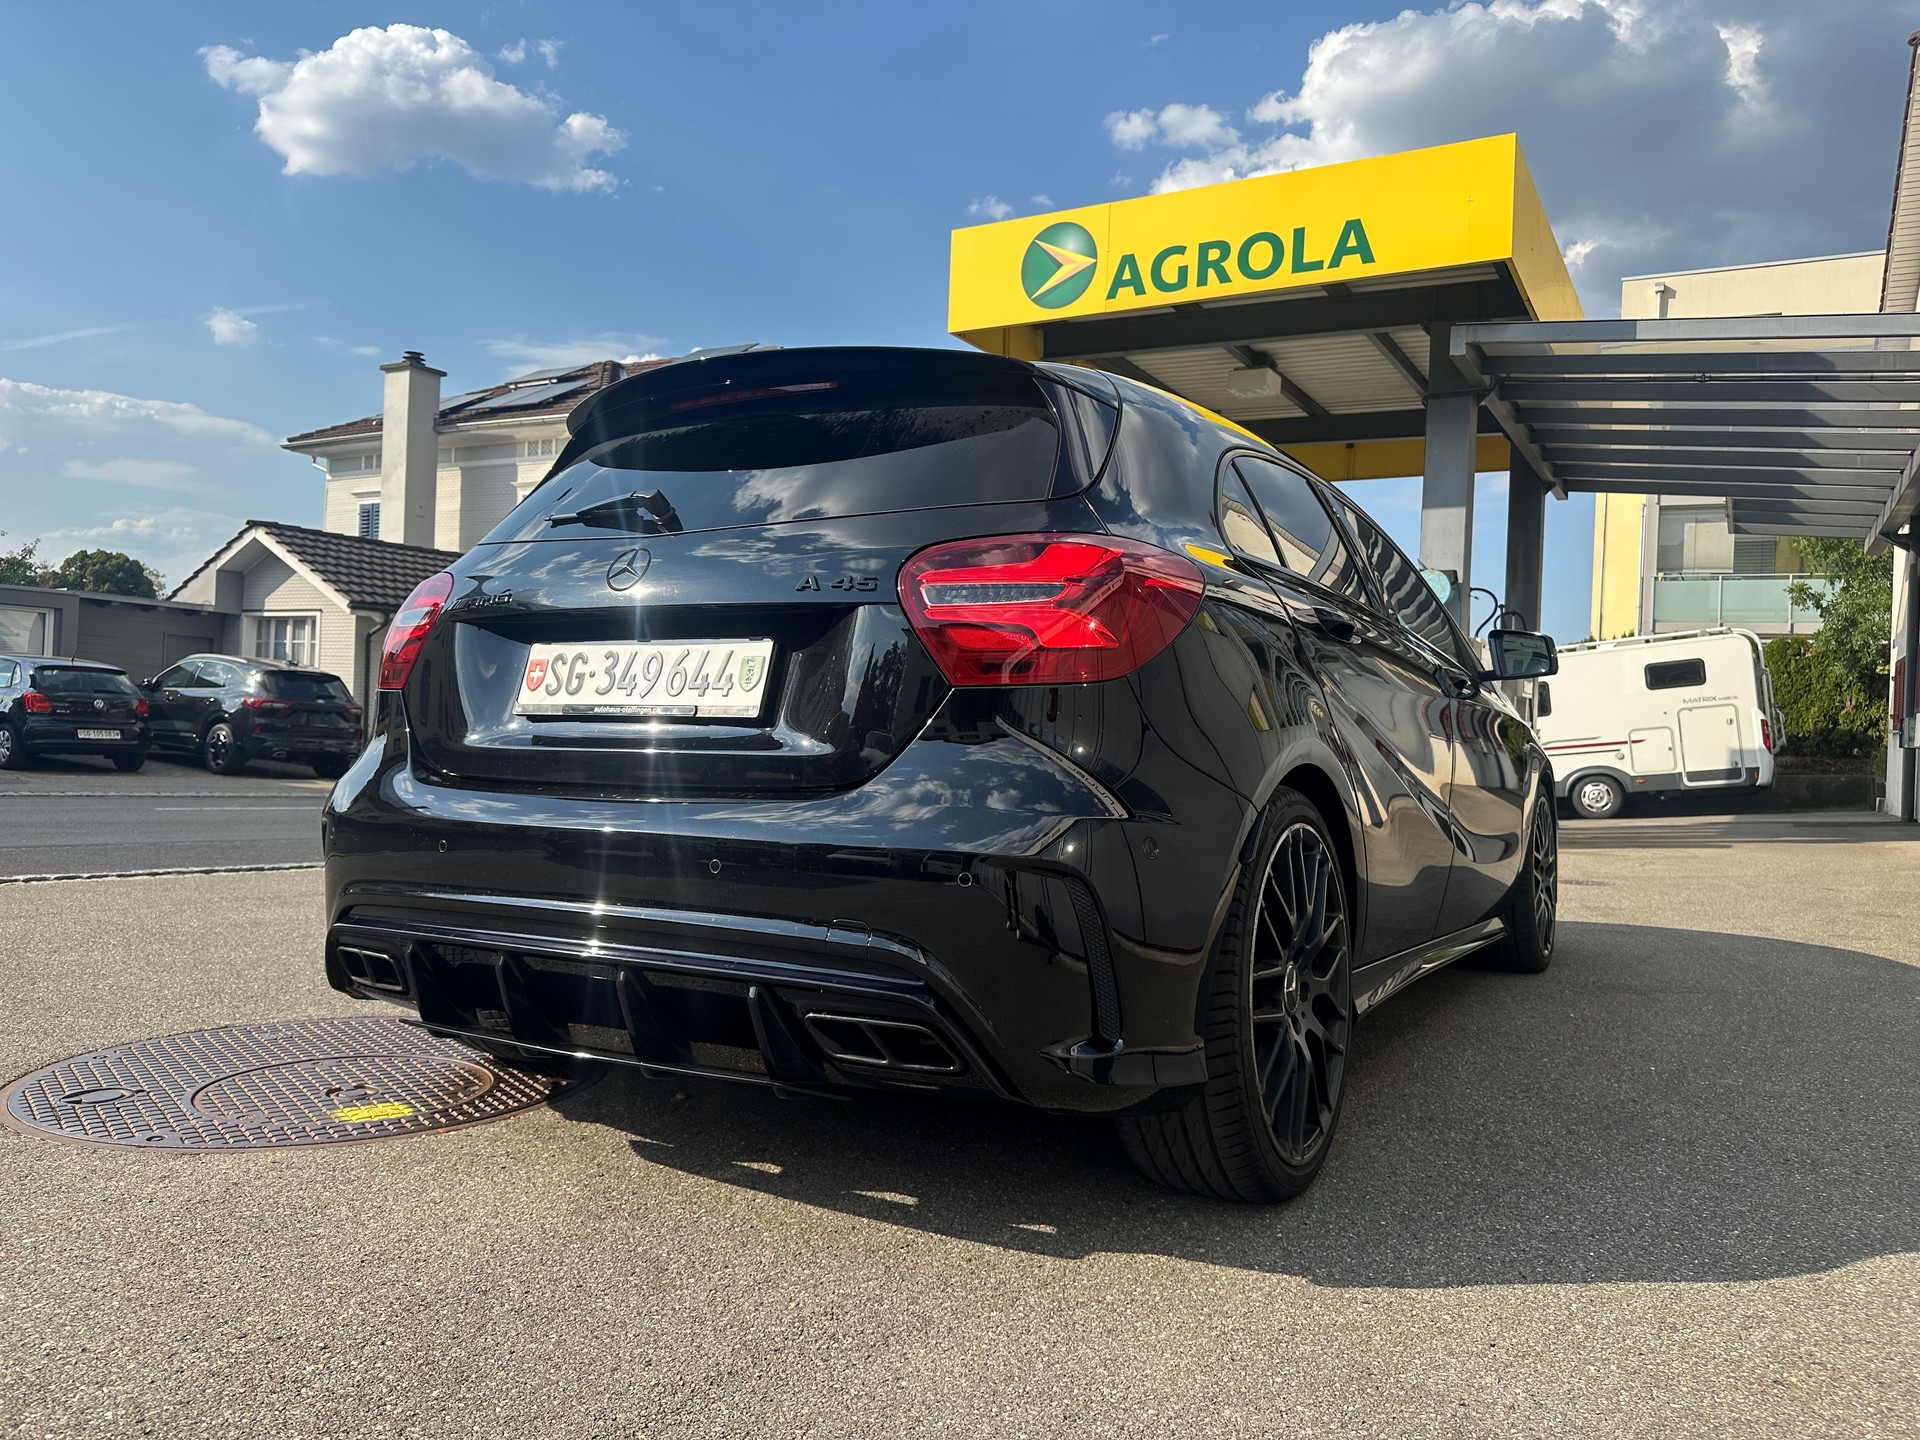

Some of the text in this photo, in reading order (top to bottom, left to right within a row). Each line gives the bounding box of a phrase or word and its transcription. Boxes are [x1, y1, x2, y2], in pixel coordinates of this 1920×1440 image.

[1105, 218, 1376, 301] AGROLA
[795, 575, 879, 592] A 45
[1682, 695, 1717, 704] MATRIX
